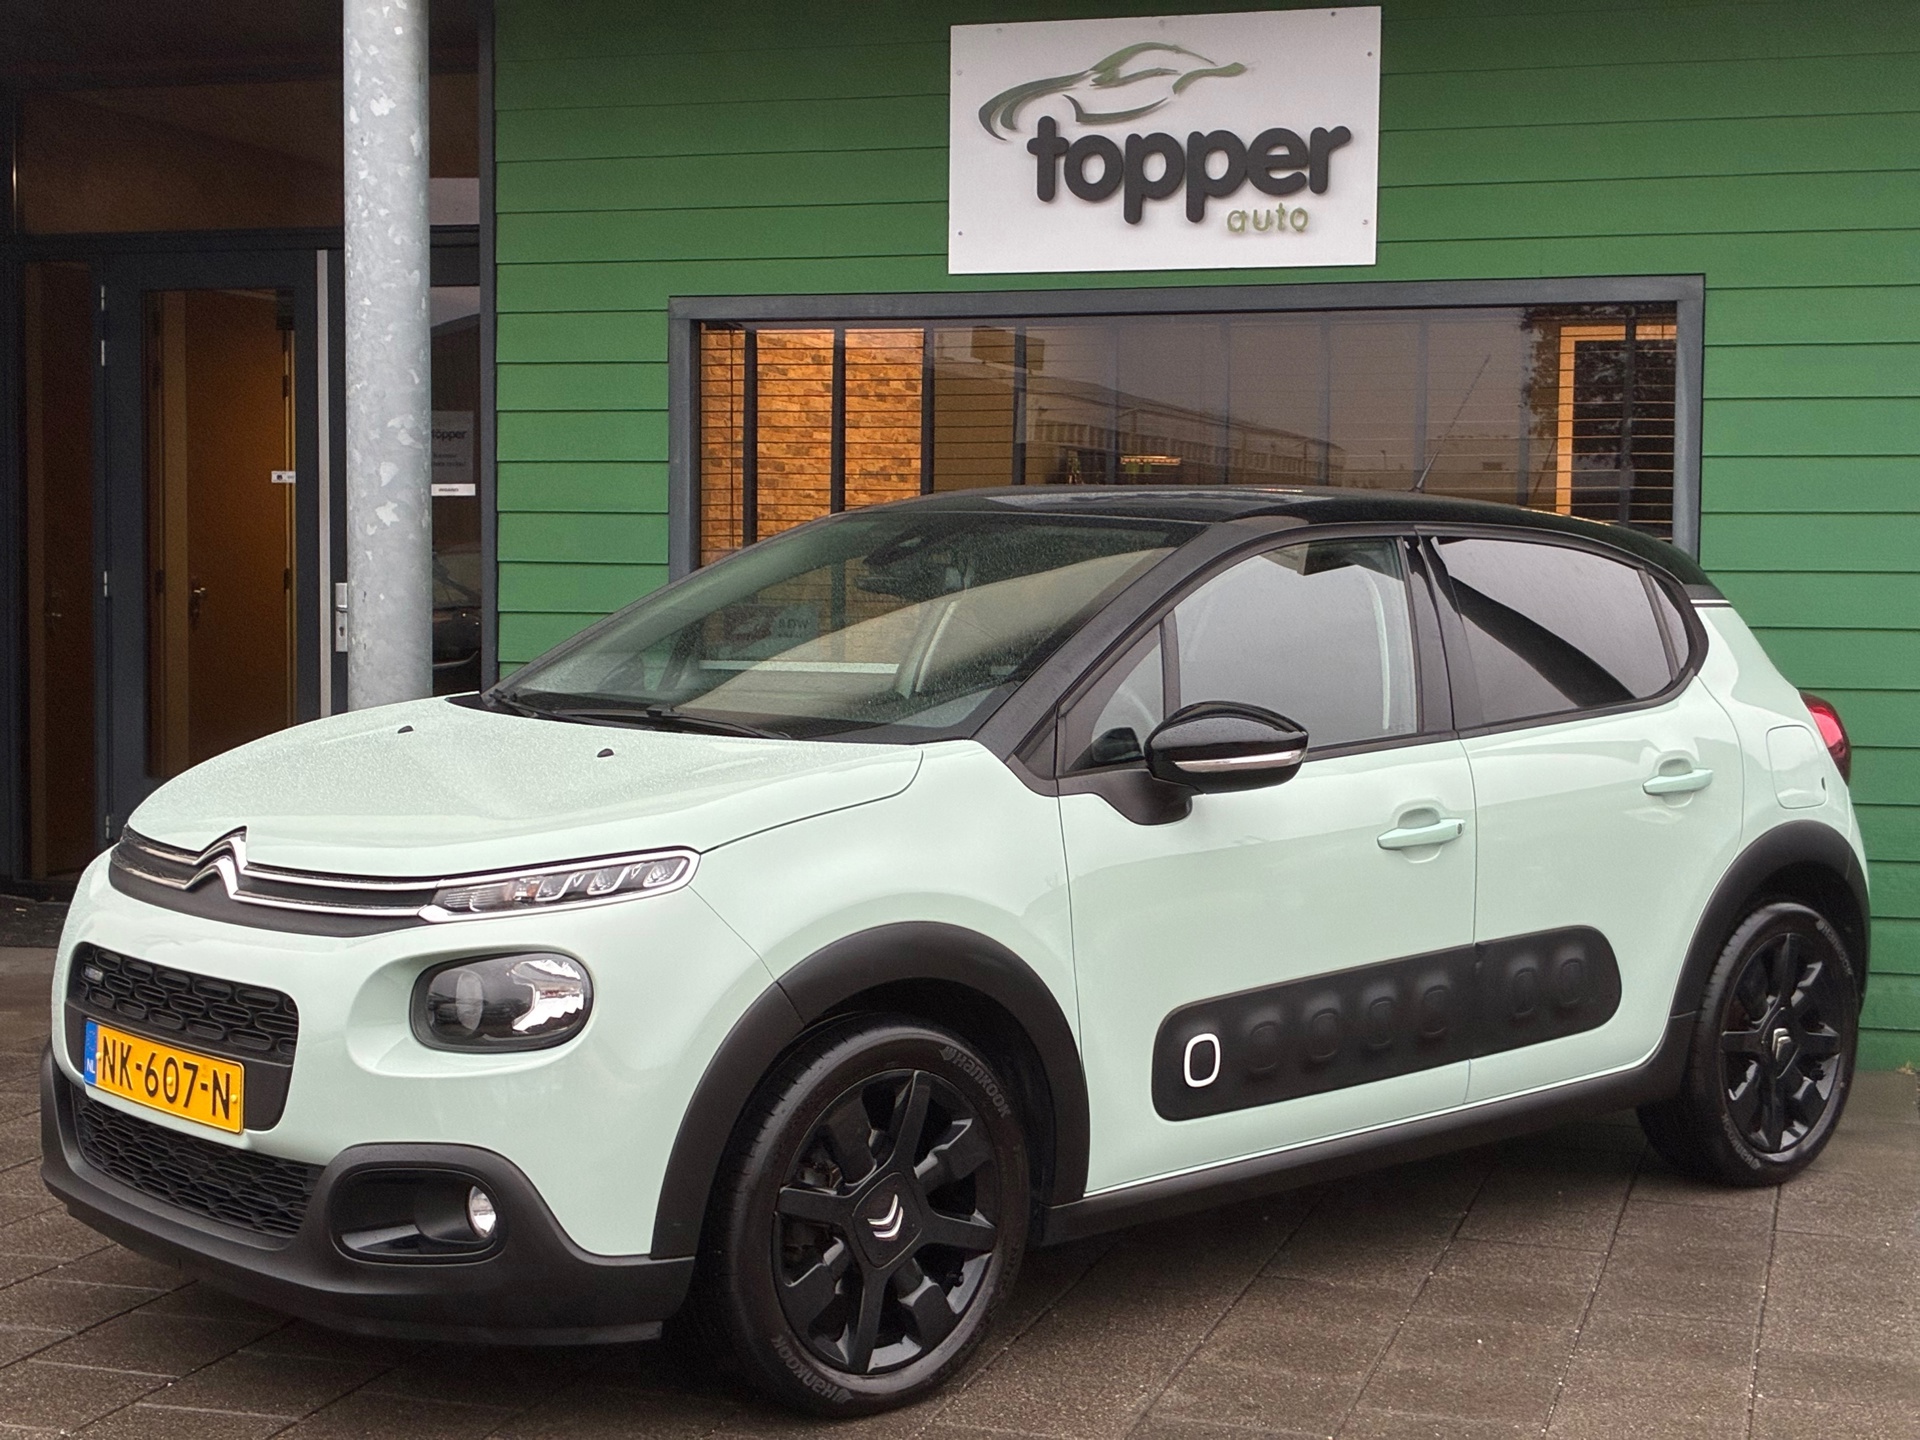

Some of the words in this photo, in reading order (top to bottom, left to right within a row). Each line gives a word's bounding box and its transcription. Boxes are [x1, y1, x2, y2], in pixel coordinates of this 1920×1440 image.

[1027, 115, 1351, 224] topper
[1227, 203, 1309, 233] auto
[86, 1058, 96, 1074] NL
[102, 1035, 231, 1121] NK-607-N
